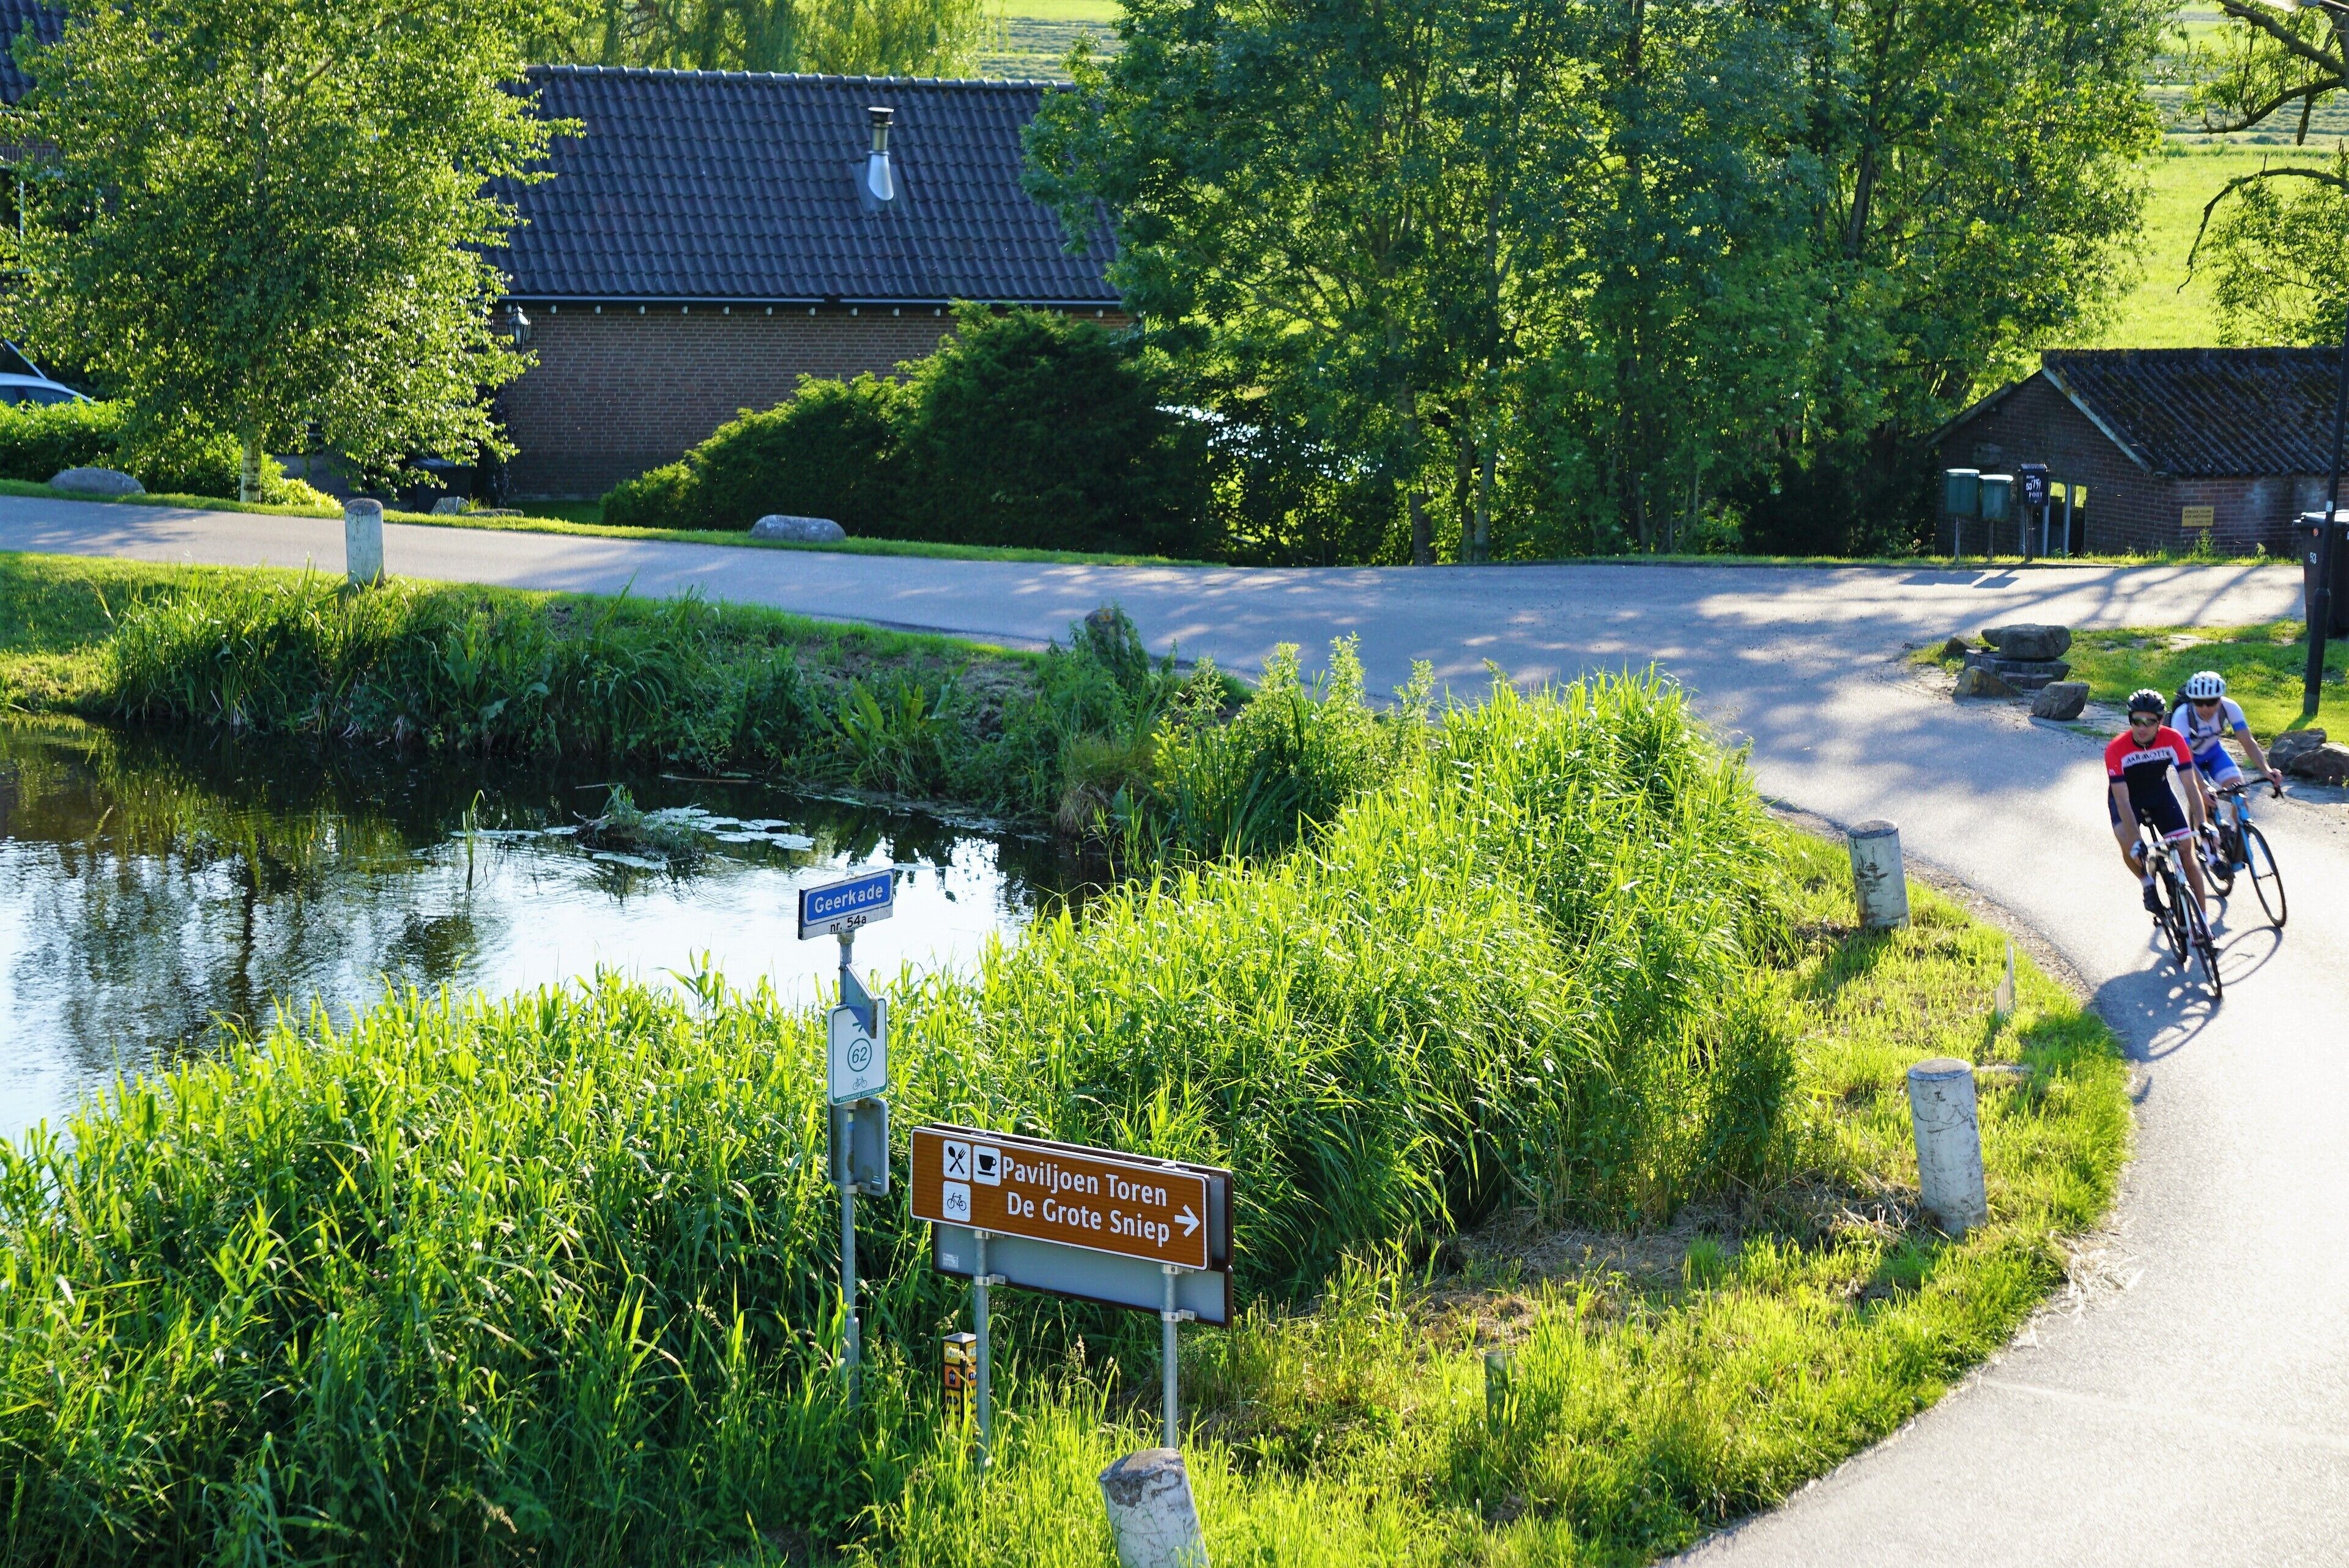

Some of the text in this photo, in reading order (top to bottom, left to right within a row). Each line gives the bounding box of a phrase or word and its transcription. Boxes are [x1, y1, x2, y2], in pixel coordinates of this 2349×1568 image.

[815, 884, 883, 914] Geerkade
[830, 915, 867, 933] nr. 54a
[852, 1046, 867, 1063] 62
[839, 1088, 880, 1102] PROVINCIE UTRECHT
[1003, 1156, 1167, 1207] Paviljoen Toren
[1008, 1191, 1170, 1248] De Grote Sniep
